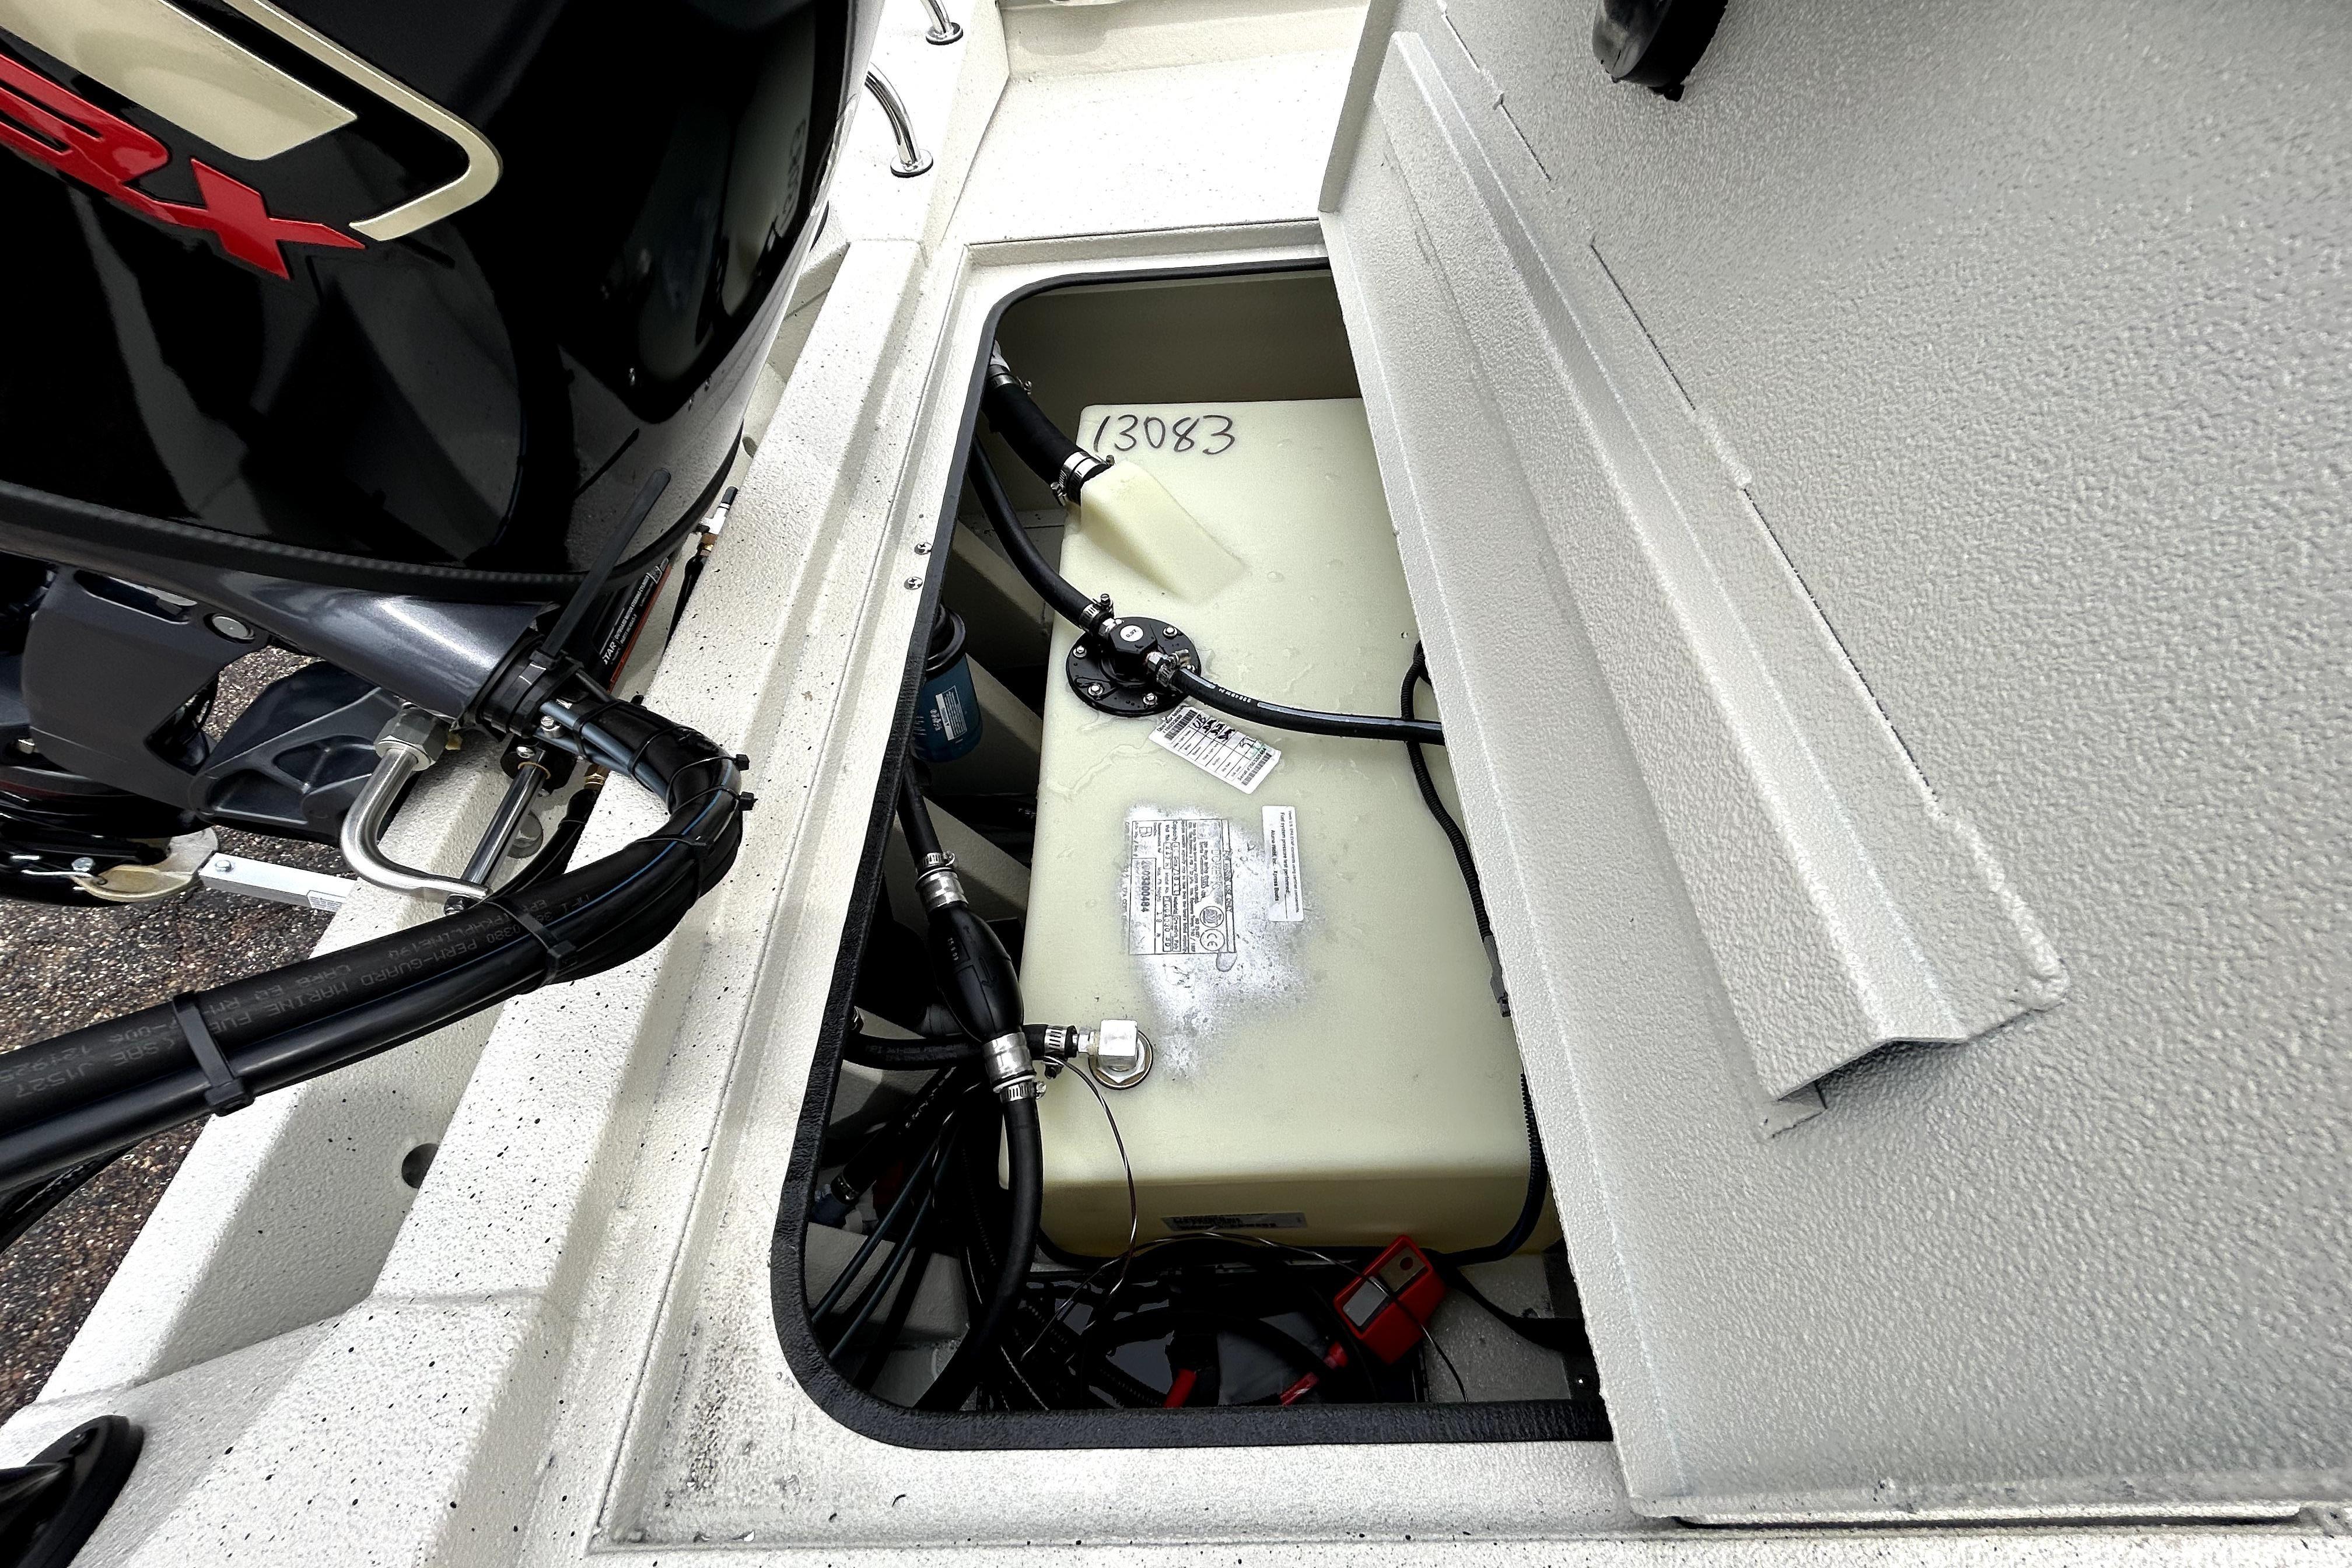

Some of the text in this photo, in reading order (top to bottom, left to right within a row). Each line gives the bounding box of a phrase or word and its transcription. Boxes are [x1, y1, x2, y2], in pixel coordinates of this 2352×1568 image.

[1093, 414, 1236, 456] 13083
[485, 909, 553, 944] 360380
[359, 938, 477, 986] PERM-GUARD
[263, 980, 349, 1017] MARINE
[206, 1011, 252, 1035] FUE
[14, 1060, 94, 1098] J1527
